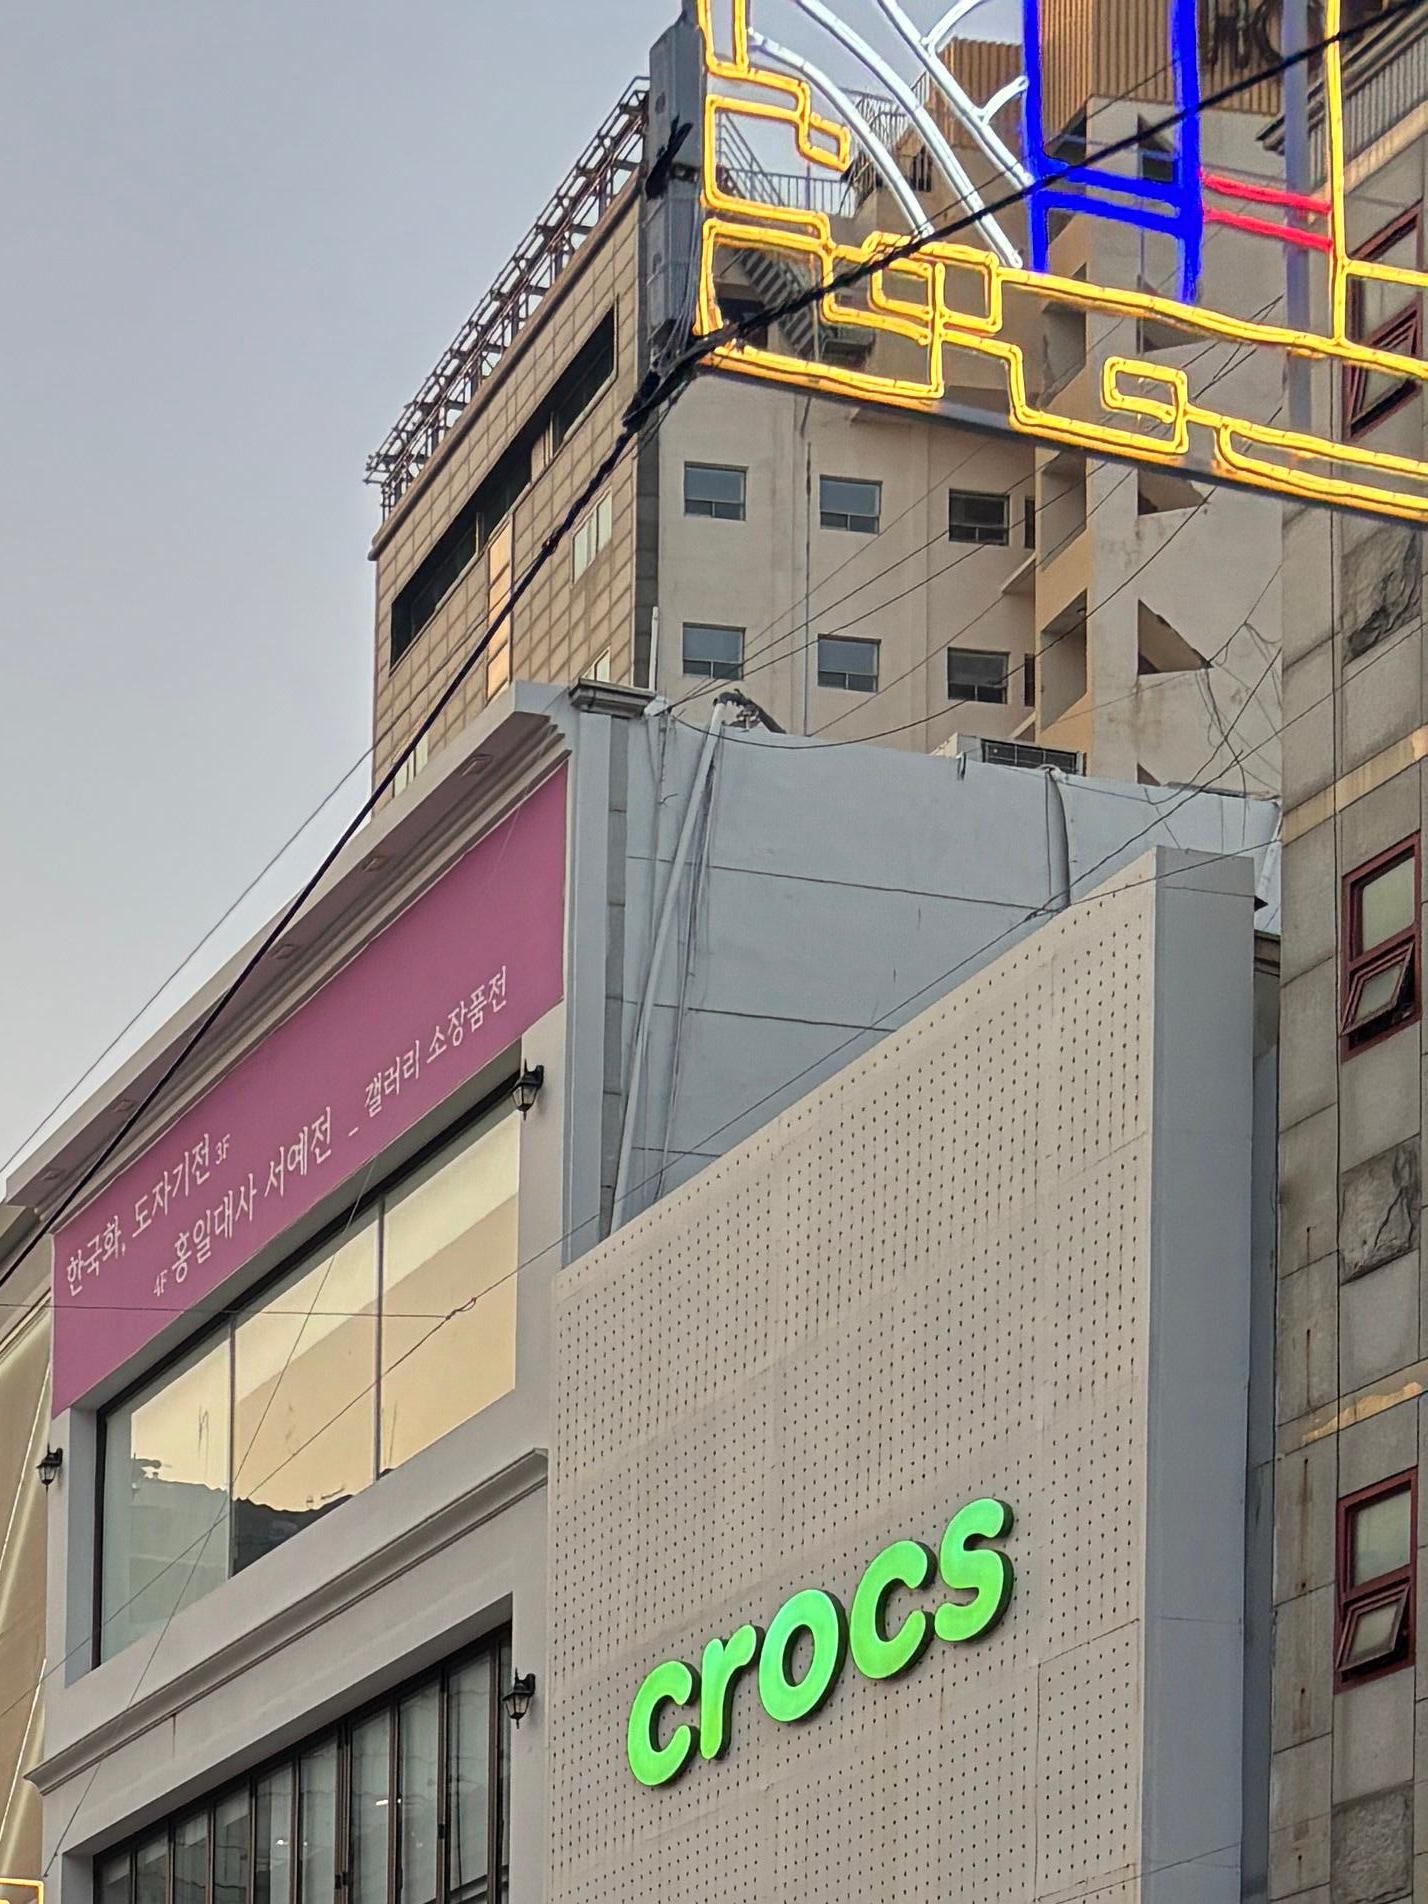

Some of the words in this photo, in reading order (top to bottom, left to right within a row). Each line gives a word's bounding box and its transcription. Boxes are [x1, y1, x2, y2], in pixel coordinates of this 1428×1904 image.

[66, 1223, 127, 1297] 한국화,
[132, 1135, 212, 1236] 도자기전
[215, 1134, 231, 1164] 3F
[153, 1270, 168, 1297] 4F
[171, 1176, 257, 1287] 홍일대사
[265, 1106, 332, 1200] 서예전
[364, 1042, 421, 1118] 갤러리
[427, 966, 509, 1063] 소장품전
[628, 1497, 1014, 1786] crocs
